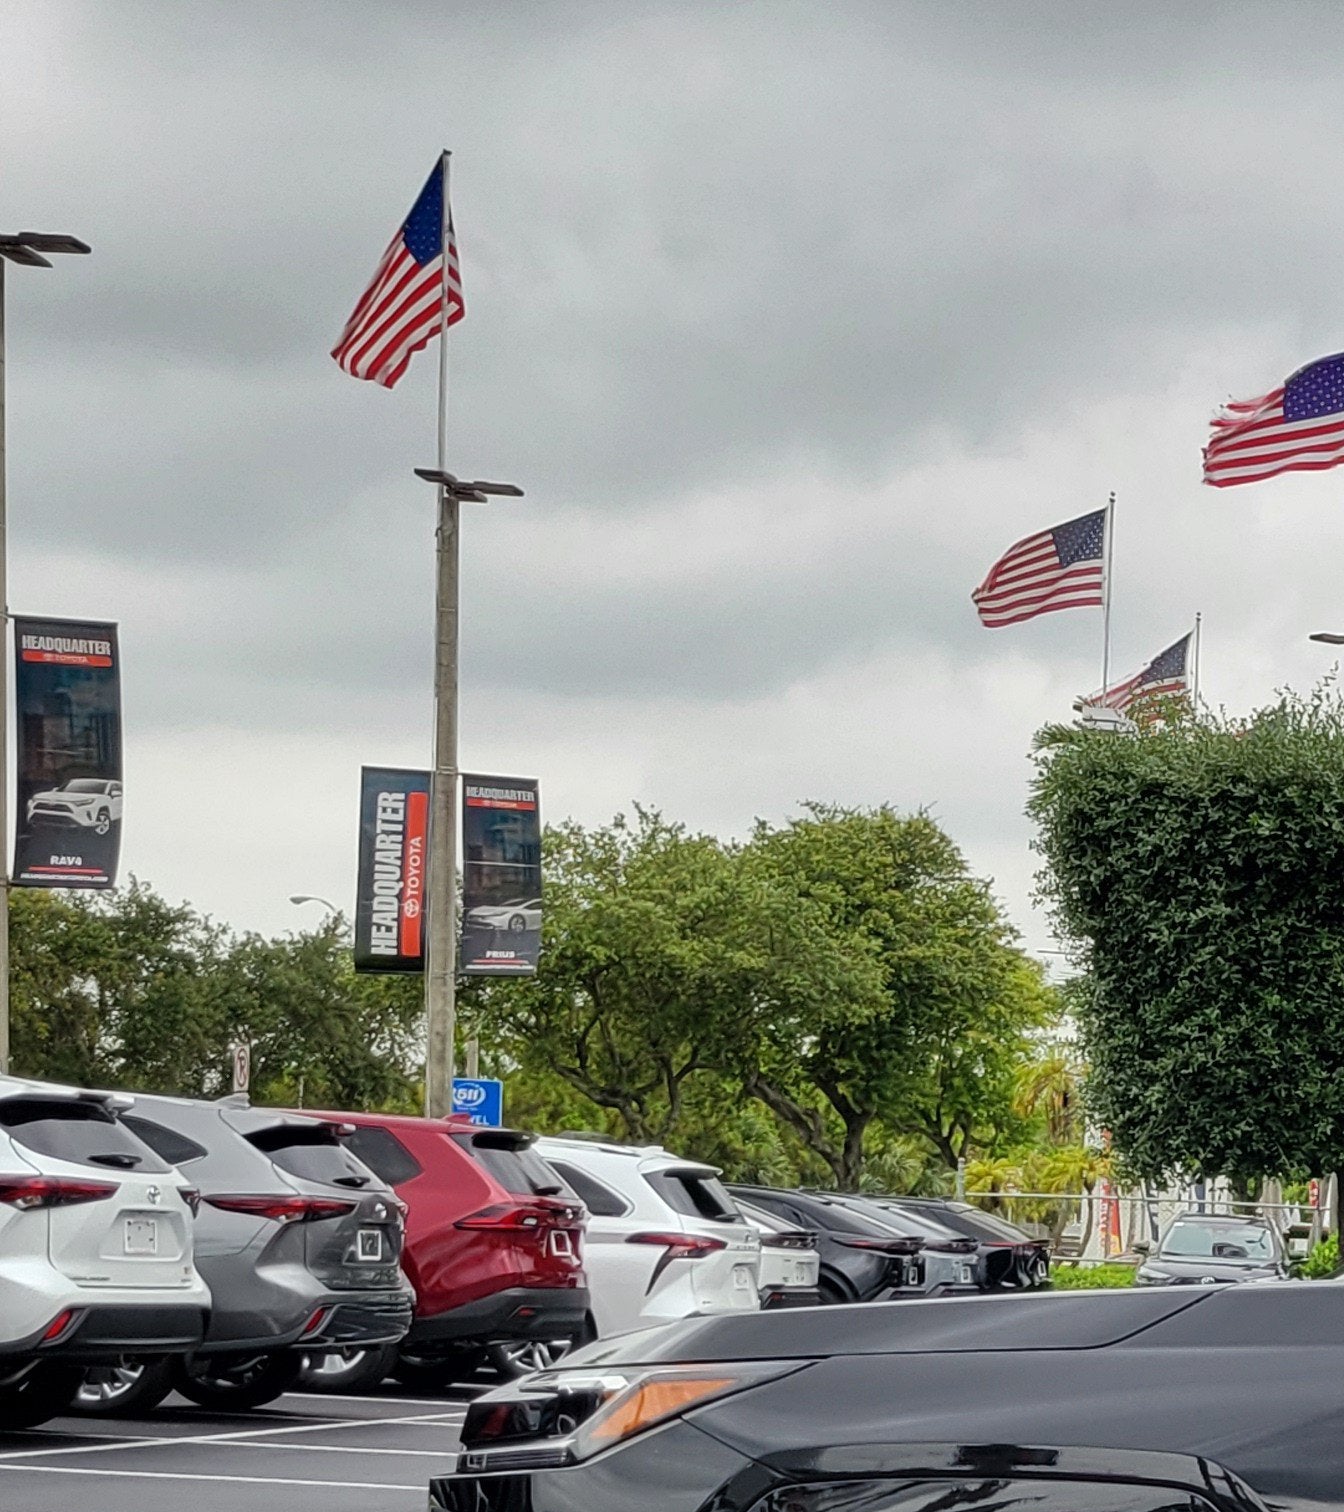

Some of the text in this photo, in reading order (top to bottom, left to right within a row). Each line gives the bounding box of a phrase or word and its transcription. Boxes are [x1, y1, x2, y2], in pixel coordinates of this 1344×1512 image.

[22, 634, 111, 656] HEADQUARTER
[466, 786, 534, 802] HEADQUARTER
[50, 855, 82, 866] RAV4
[406, 836, 423, 896] TOYOTA
[370, 791, 406, 956] HEADQUARTER
